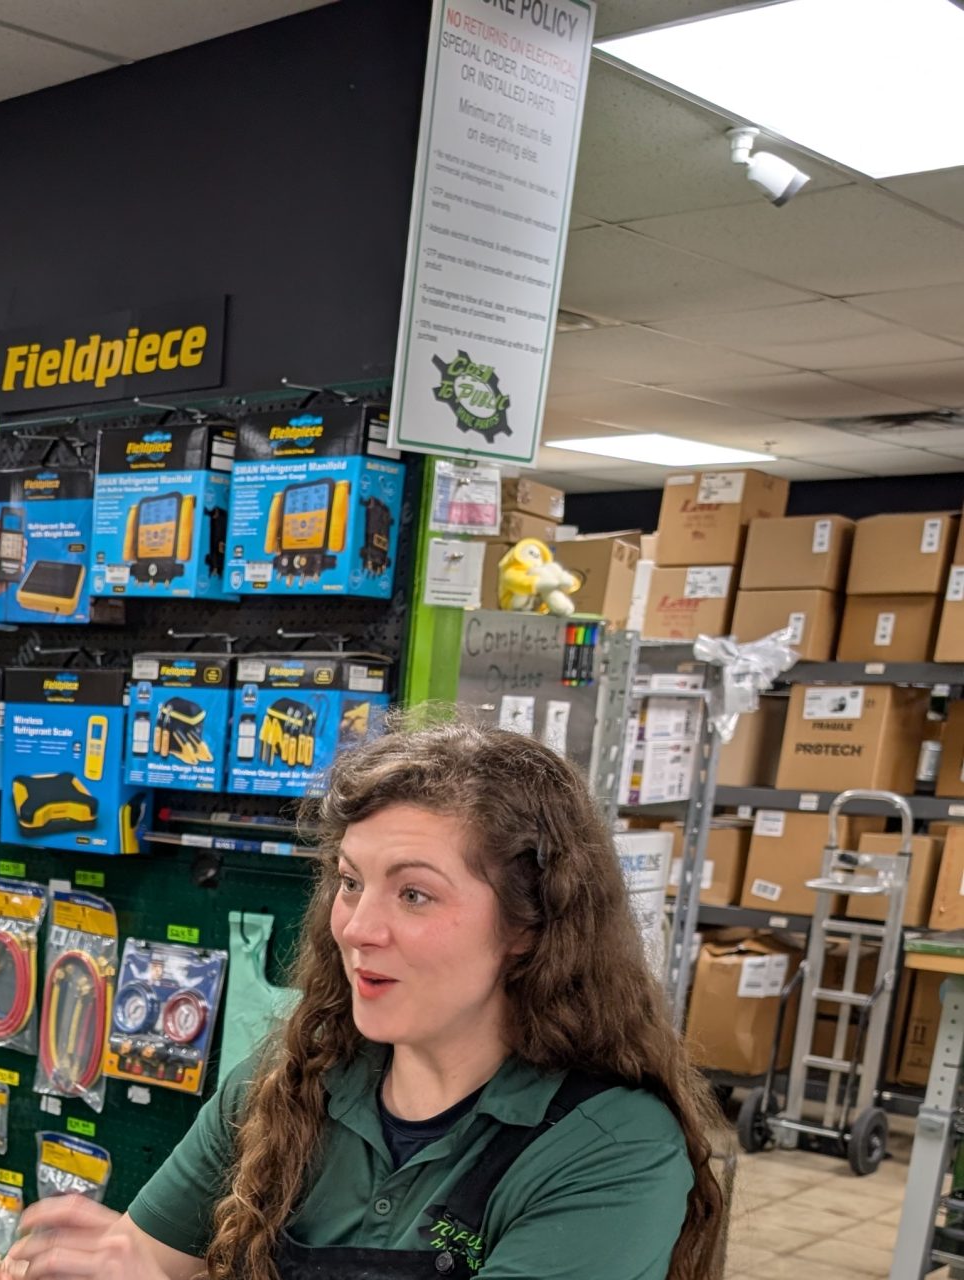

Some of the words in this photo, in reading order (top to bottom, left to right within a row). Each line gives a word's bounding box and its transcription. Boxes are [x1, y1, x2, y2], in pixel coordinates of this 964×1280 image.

[446, 8, 462, 28] NO
[463, 15, 508, 49] RETURNS
[510, 36, 525, 55] ON
[520, 0, 578, 41] POLICY
[442, 31, 482, 62] SPECIAL
[521, 65, 576, 101] DISCOUNTED
[461, 64, 476, 83] OR
[478, 71, 526, 103] INSTALLED
[459, 97, 496, 124] Minimum
[467, 128, 478, 140] on
[480, 132, 520, 160] everything
[2, 325, 207, 391] Fieldpiece
[269, 426, 324, 440] Fieldpiece
[126, 441, 173, 455] Fieldpiece
[260, 463, 307, 476] Refrigerant
[308, 461, 347, 472] Manifold
[466, 617, 561, 662] Completed
[485, 663, 543, 693] Orders
[13, 716, 44, 725] Wireless
[13, 726, 52, 737] Refrigerant
[53, 728, 73, 737] Scale
[812, 722, 853, 731] FRAGILE
[795, 743, 863, 757] PROTECH
